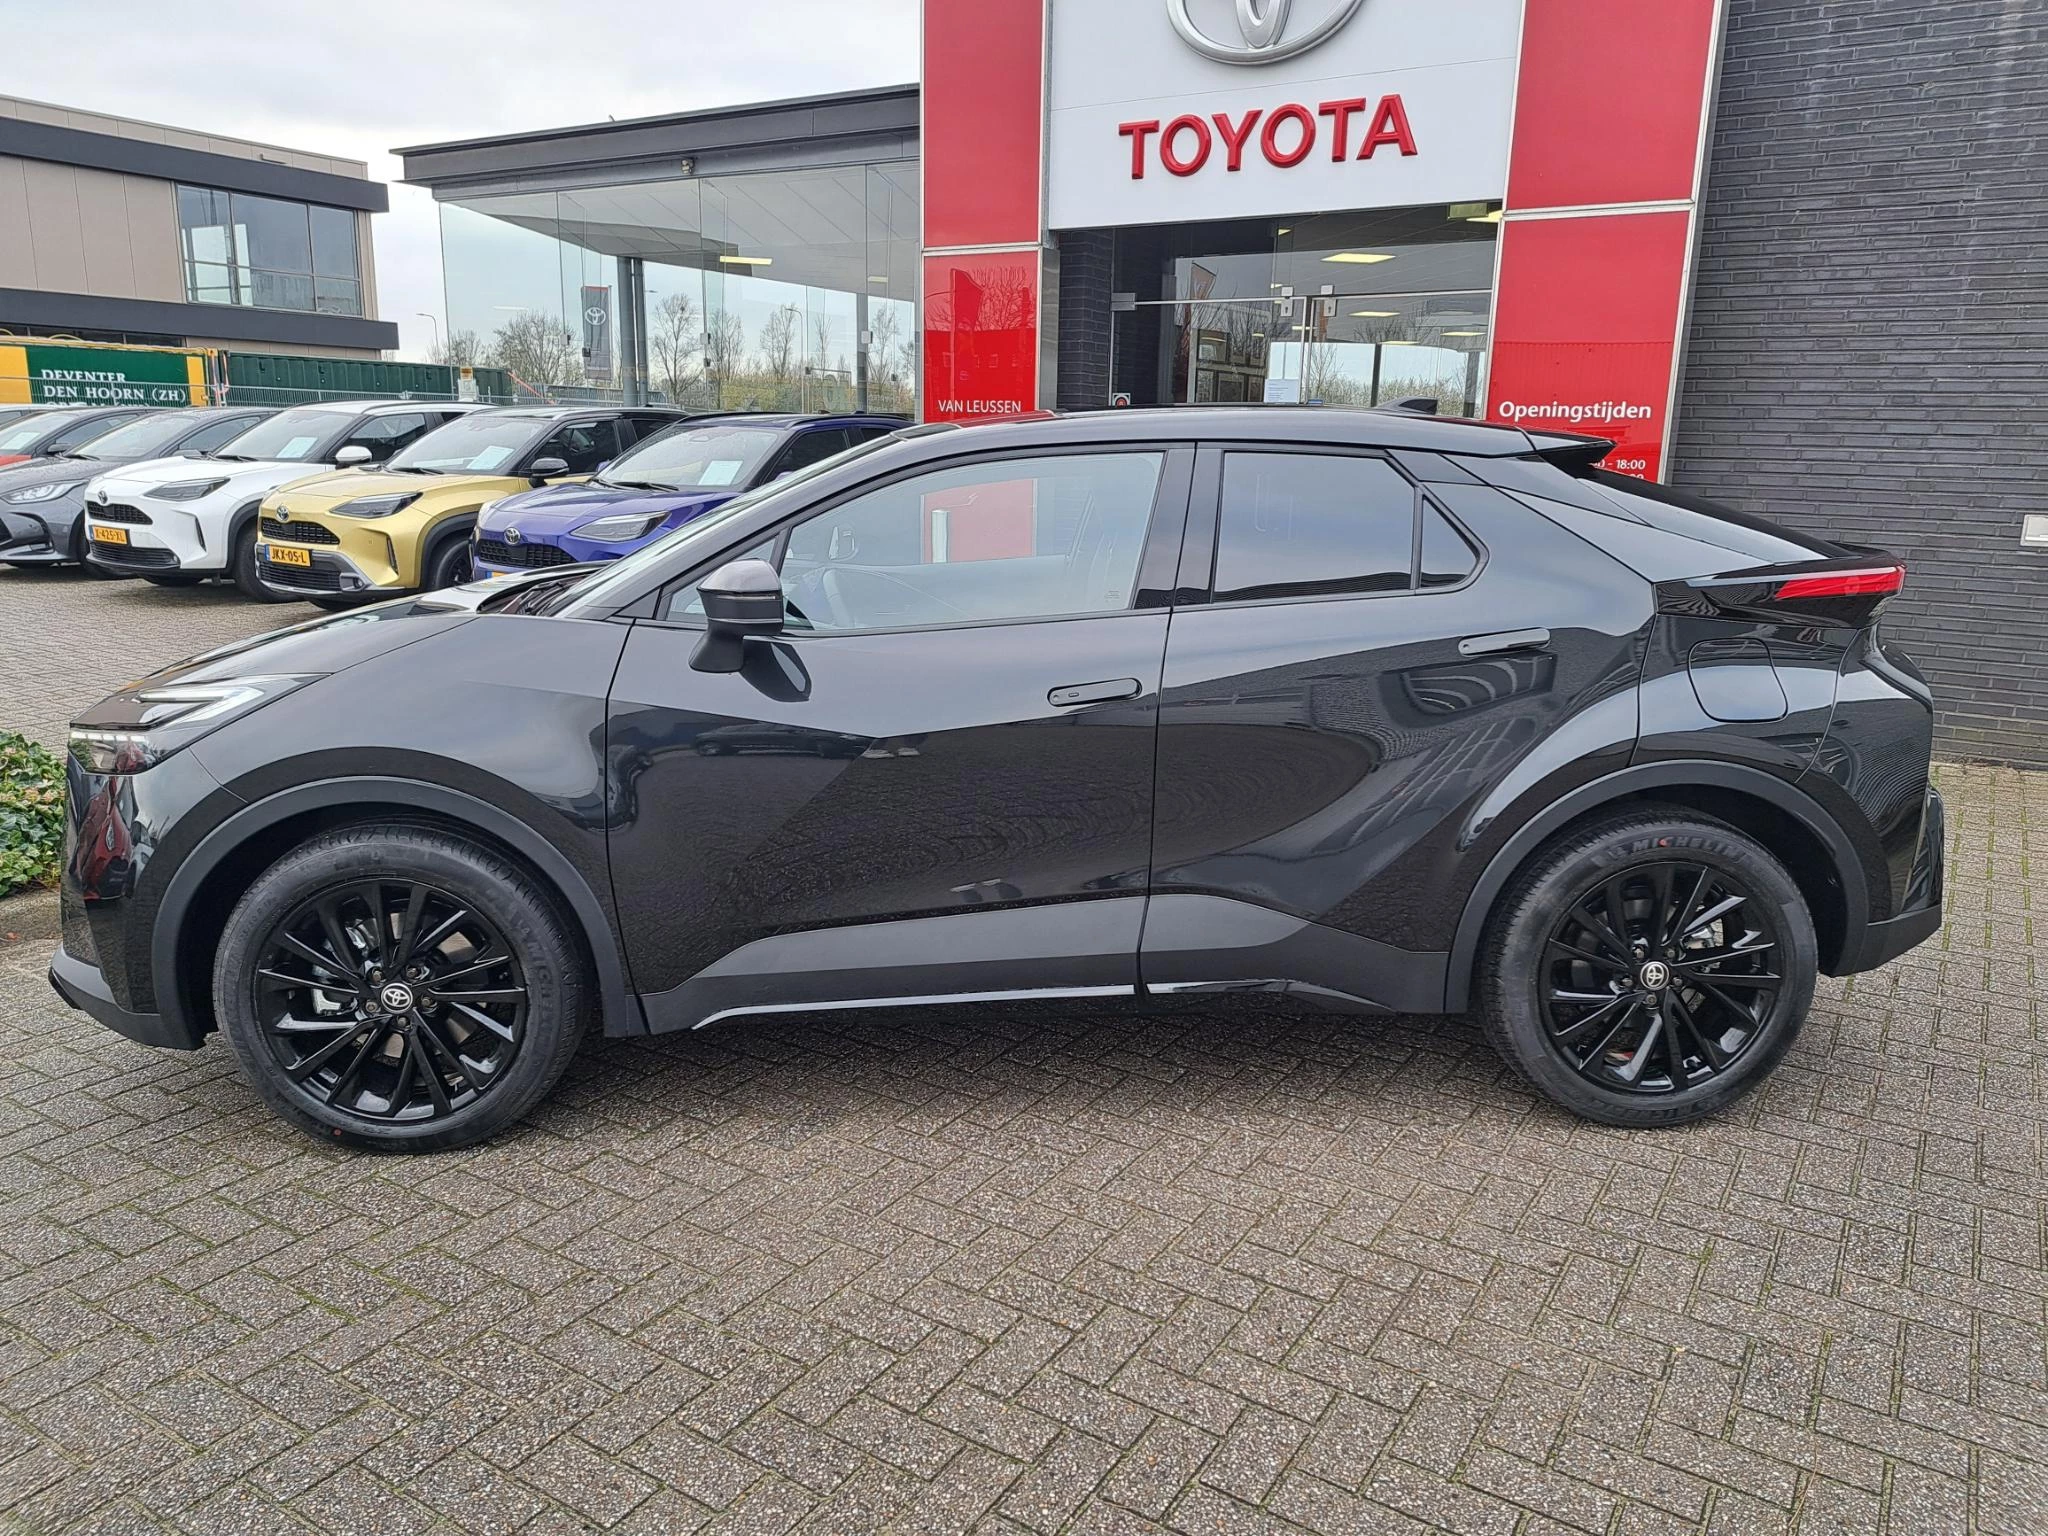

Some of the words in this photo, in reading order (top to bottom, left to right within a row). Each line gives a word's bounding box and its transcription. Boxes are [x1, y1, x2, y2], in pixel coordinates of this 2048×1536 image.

[1118, 93, 1418, 180] TOYOTA
[41, 369, 126, 383] DEVENTER
[43, 386, 78, 398] DEN
[86, 387, 145, 400] HOORN
[151, 388, 186, 402] (ZH)
[938, 399, 963, 412] VAN
[966, 400, 1021, 413] LEUSSEN
[1499, 401, 1652, 422] Openingstijden
[1616, 459, 1646, 470] 18:00
[271, 547, 307, 564] JKX-05-L
